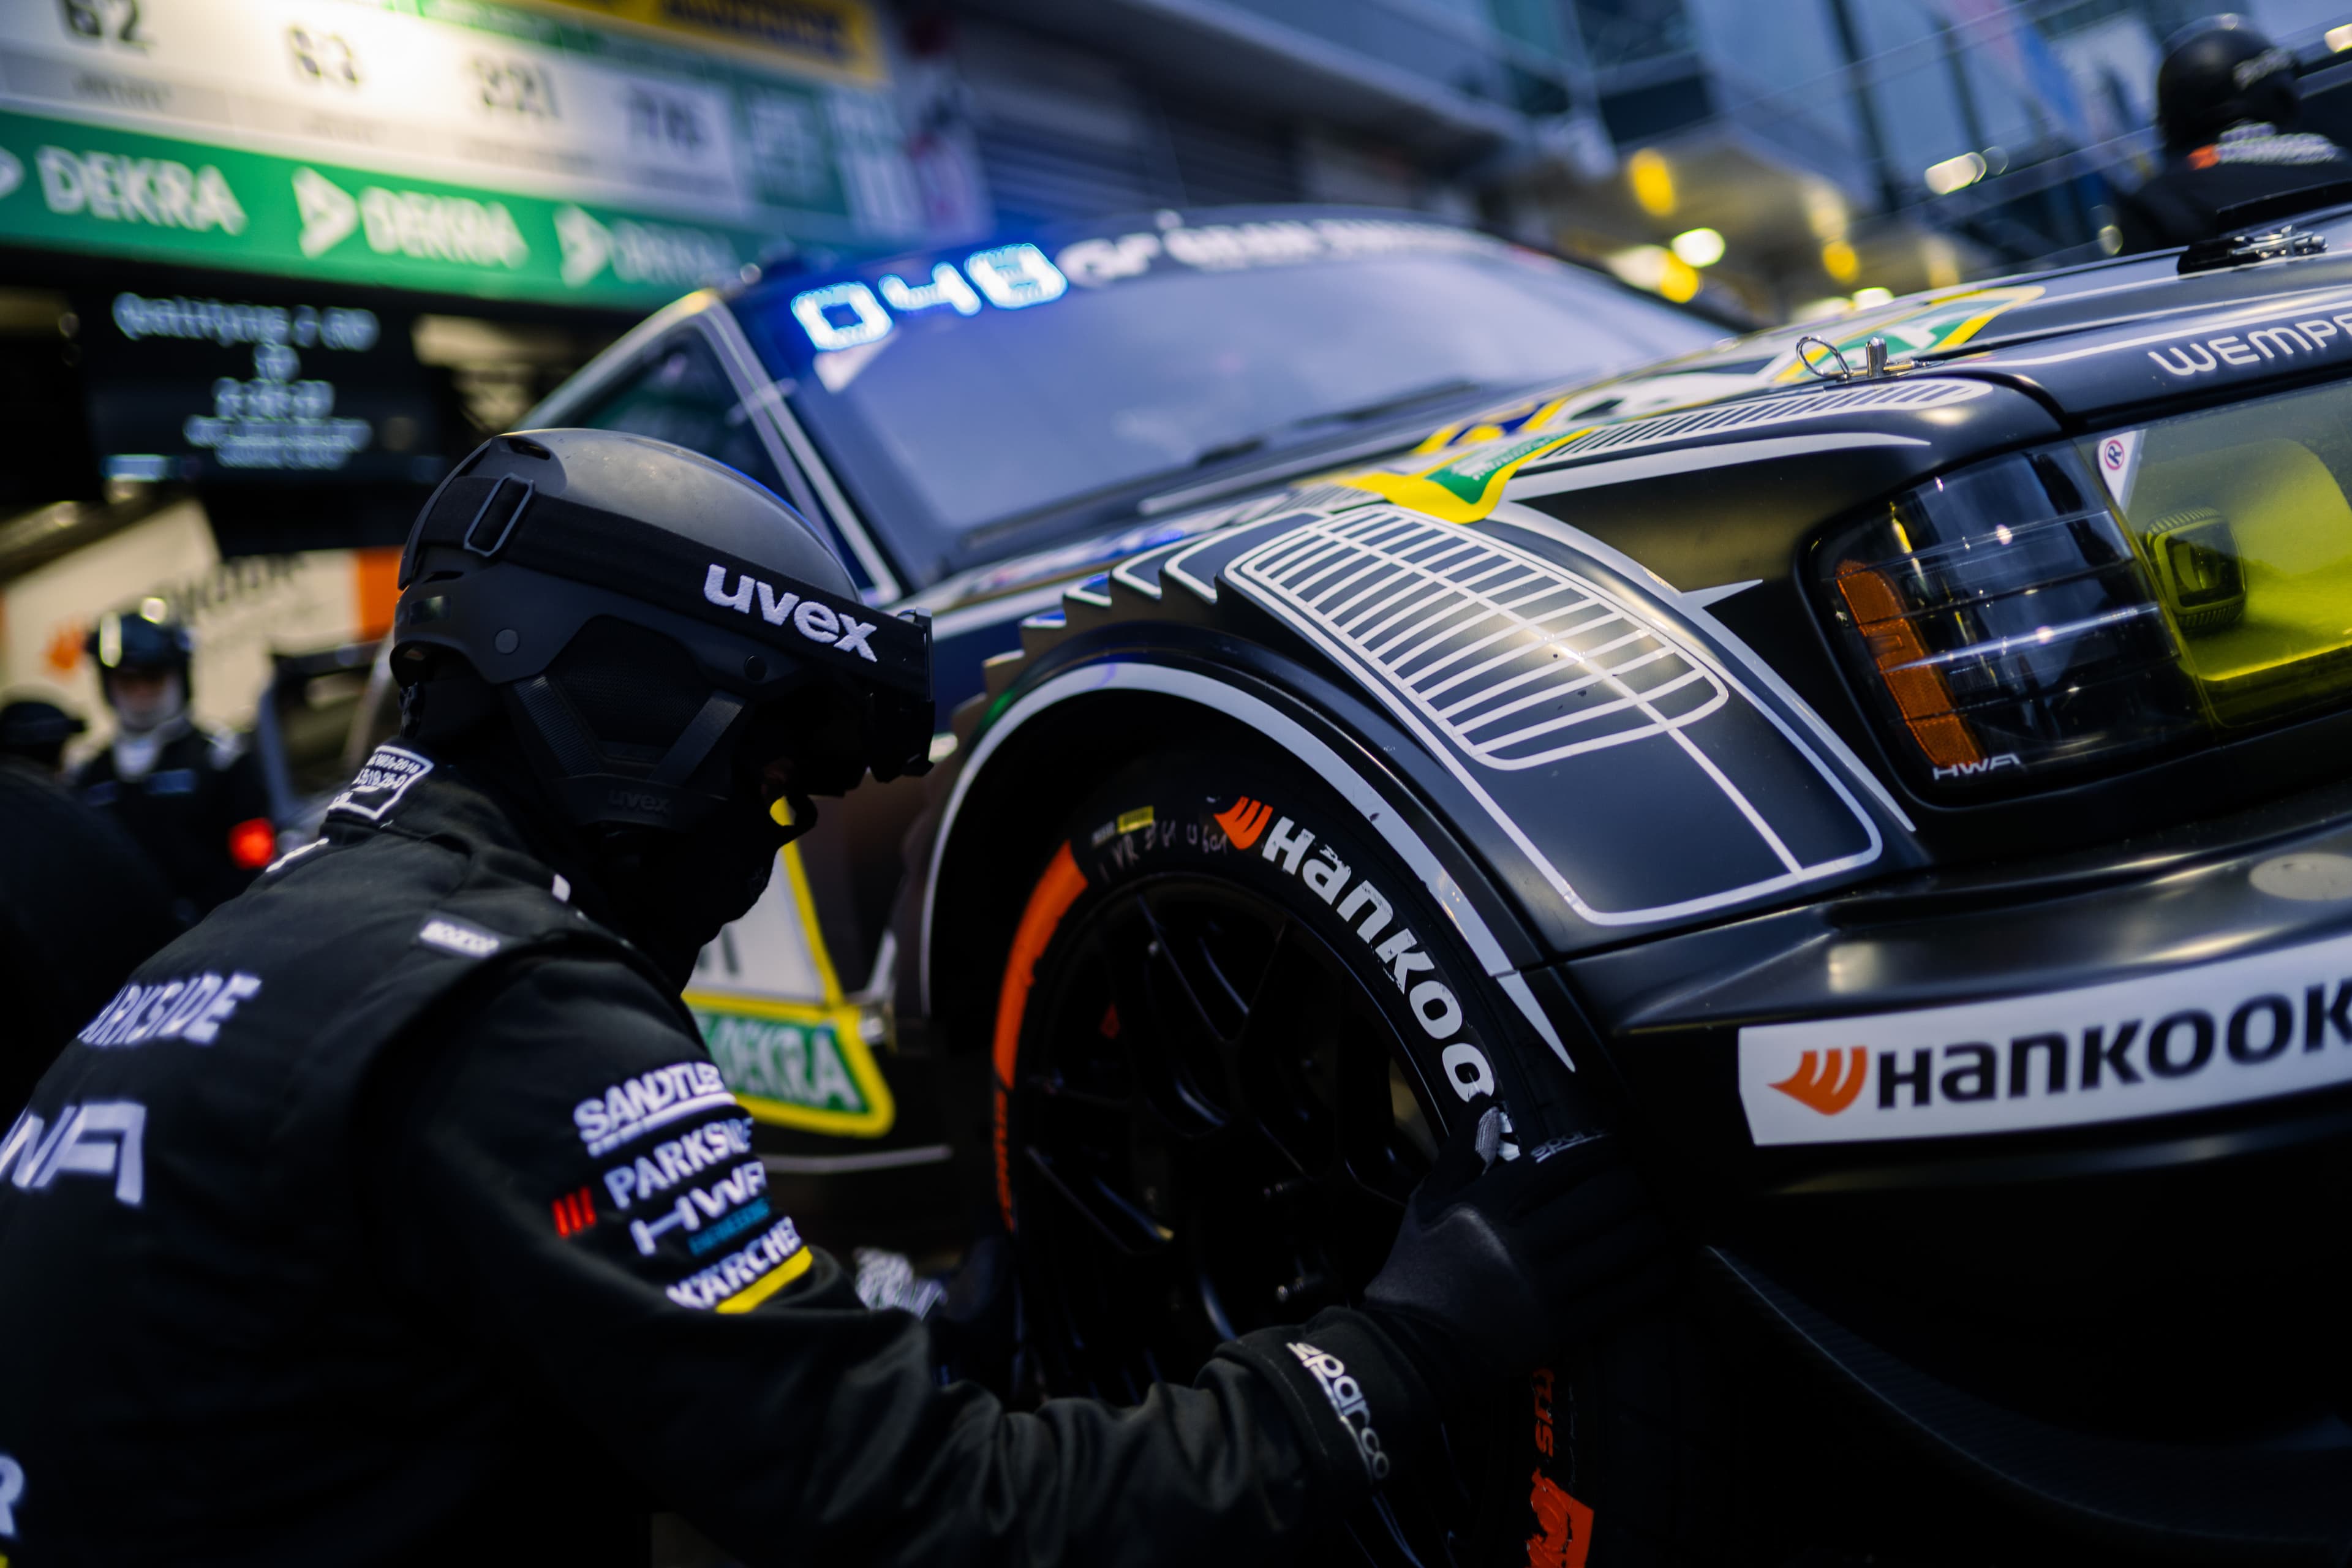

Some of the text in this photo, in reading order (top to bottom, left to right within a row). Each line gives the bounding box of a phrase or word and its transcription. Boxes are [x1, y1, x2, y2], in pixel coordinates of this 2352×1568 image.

[35, 145, 246, 236] DEKRA
[360, 186, 530, 270] DEKRA
[791, 243, 1068, 352] 048
[703, 564, 878, 663] uvex
[1932, 753, 2021, 780] HWA
[698, 1012, 865, 1112] EKRA
[1285, 1341, 1390, 1481] sparco
